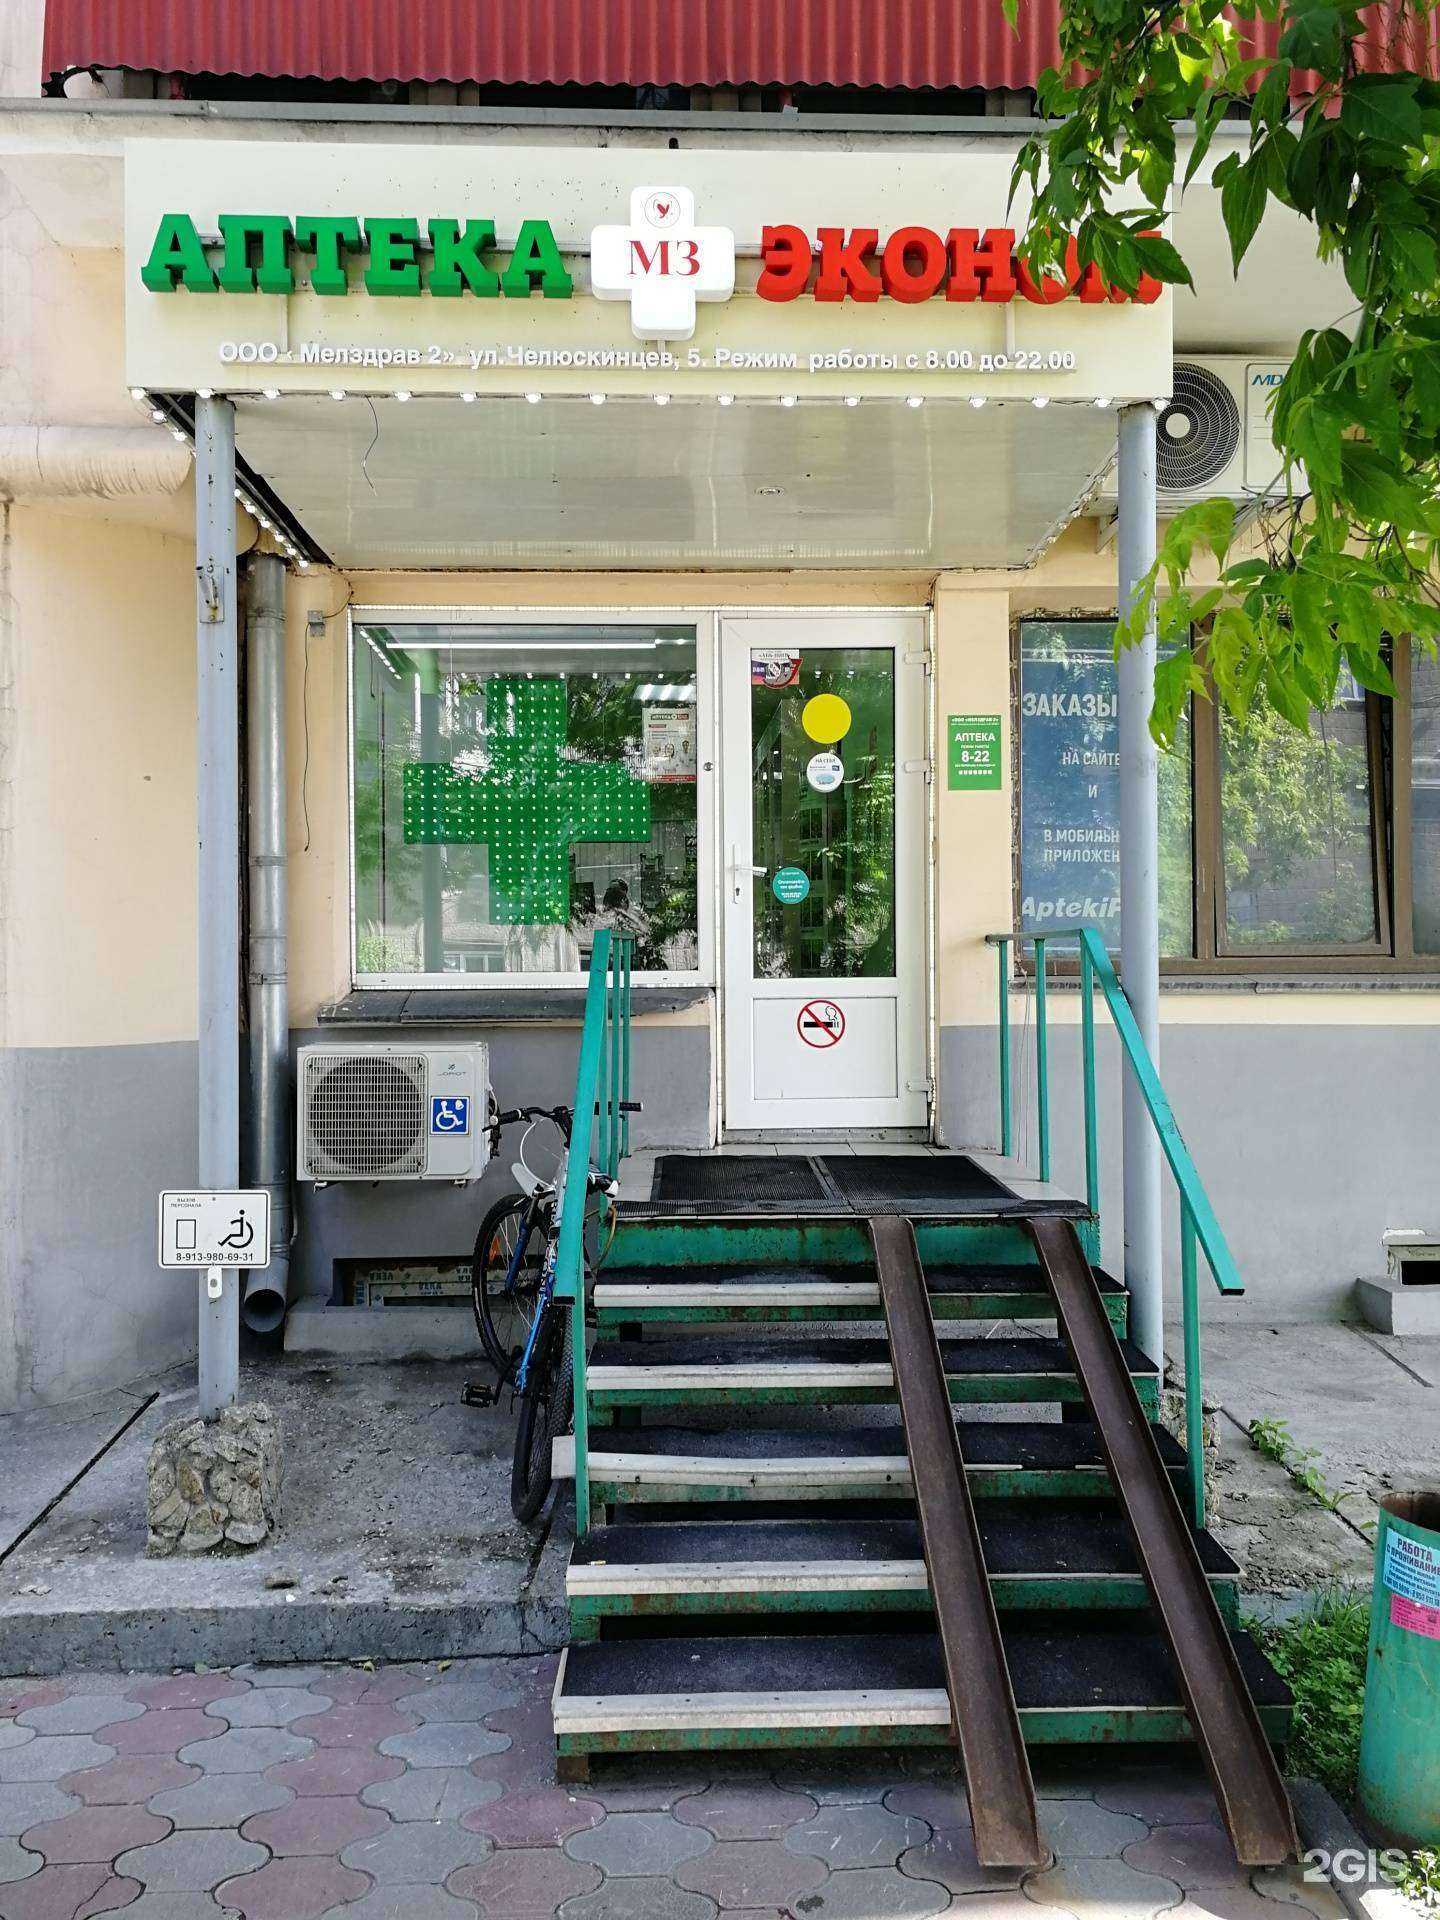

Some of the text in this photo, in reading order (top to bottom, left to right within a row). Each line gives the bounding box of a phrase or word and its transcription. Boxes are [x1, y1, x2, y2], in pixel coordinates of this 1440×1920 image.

[141, 213, 573, 299] АПТЕКА
[219, 341, 279, 363] ООО
[300, 343, 422, 369] Мелздрав
[428, 344, 456, 364] 2»
[687, 347, 707, 368] 5.
[715, 347, 797, 368] Режим
[809, 350, 897, 372] работы
[905, 353, 919, 369] с
[979, 353, 1008, 372] до
[1014, 350, 1076, 371] 22.00
[1022, 692, 1118, 717] ЗАКАЗЫ
[954, 732, 996, 742] АПТЕКА
[961, 750, 990, 763] 8-22
[1062, 749, 1120, 766] НА САЙТЕ
[1088, 785, 1098, 798] И
[1044, 829, 1052, 842] В
[1044, 849, 1120, 862] ПРИЛОЖЕН
[176, 1252, 254, 1261] 8-913-980-69-31
[1398, 1538, 1433, 1561] РАБОТА
